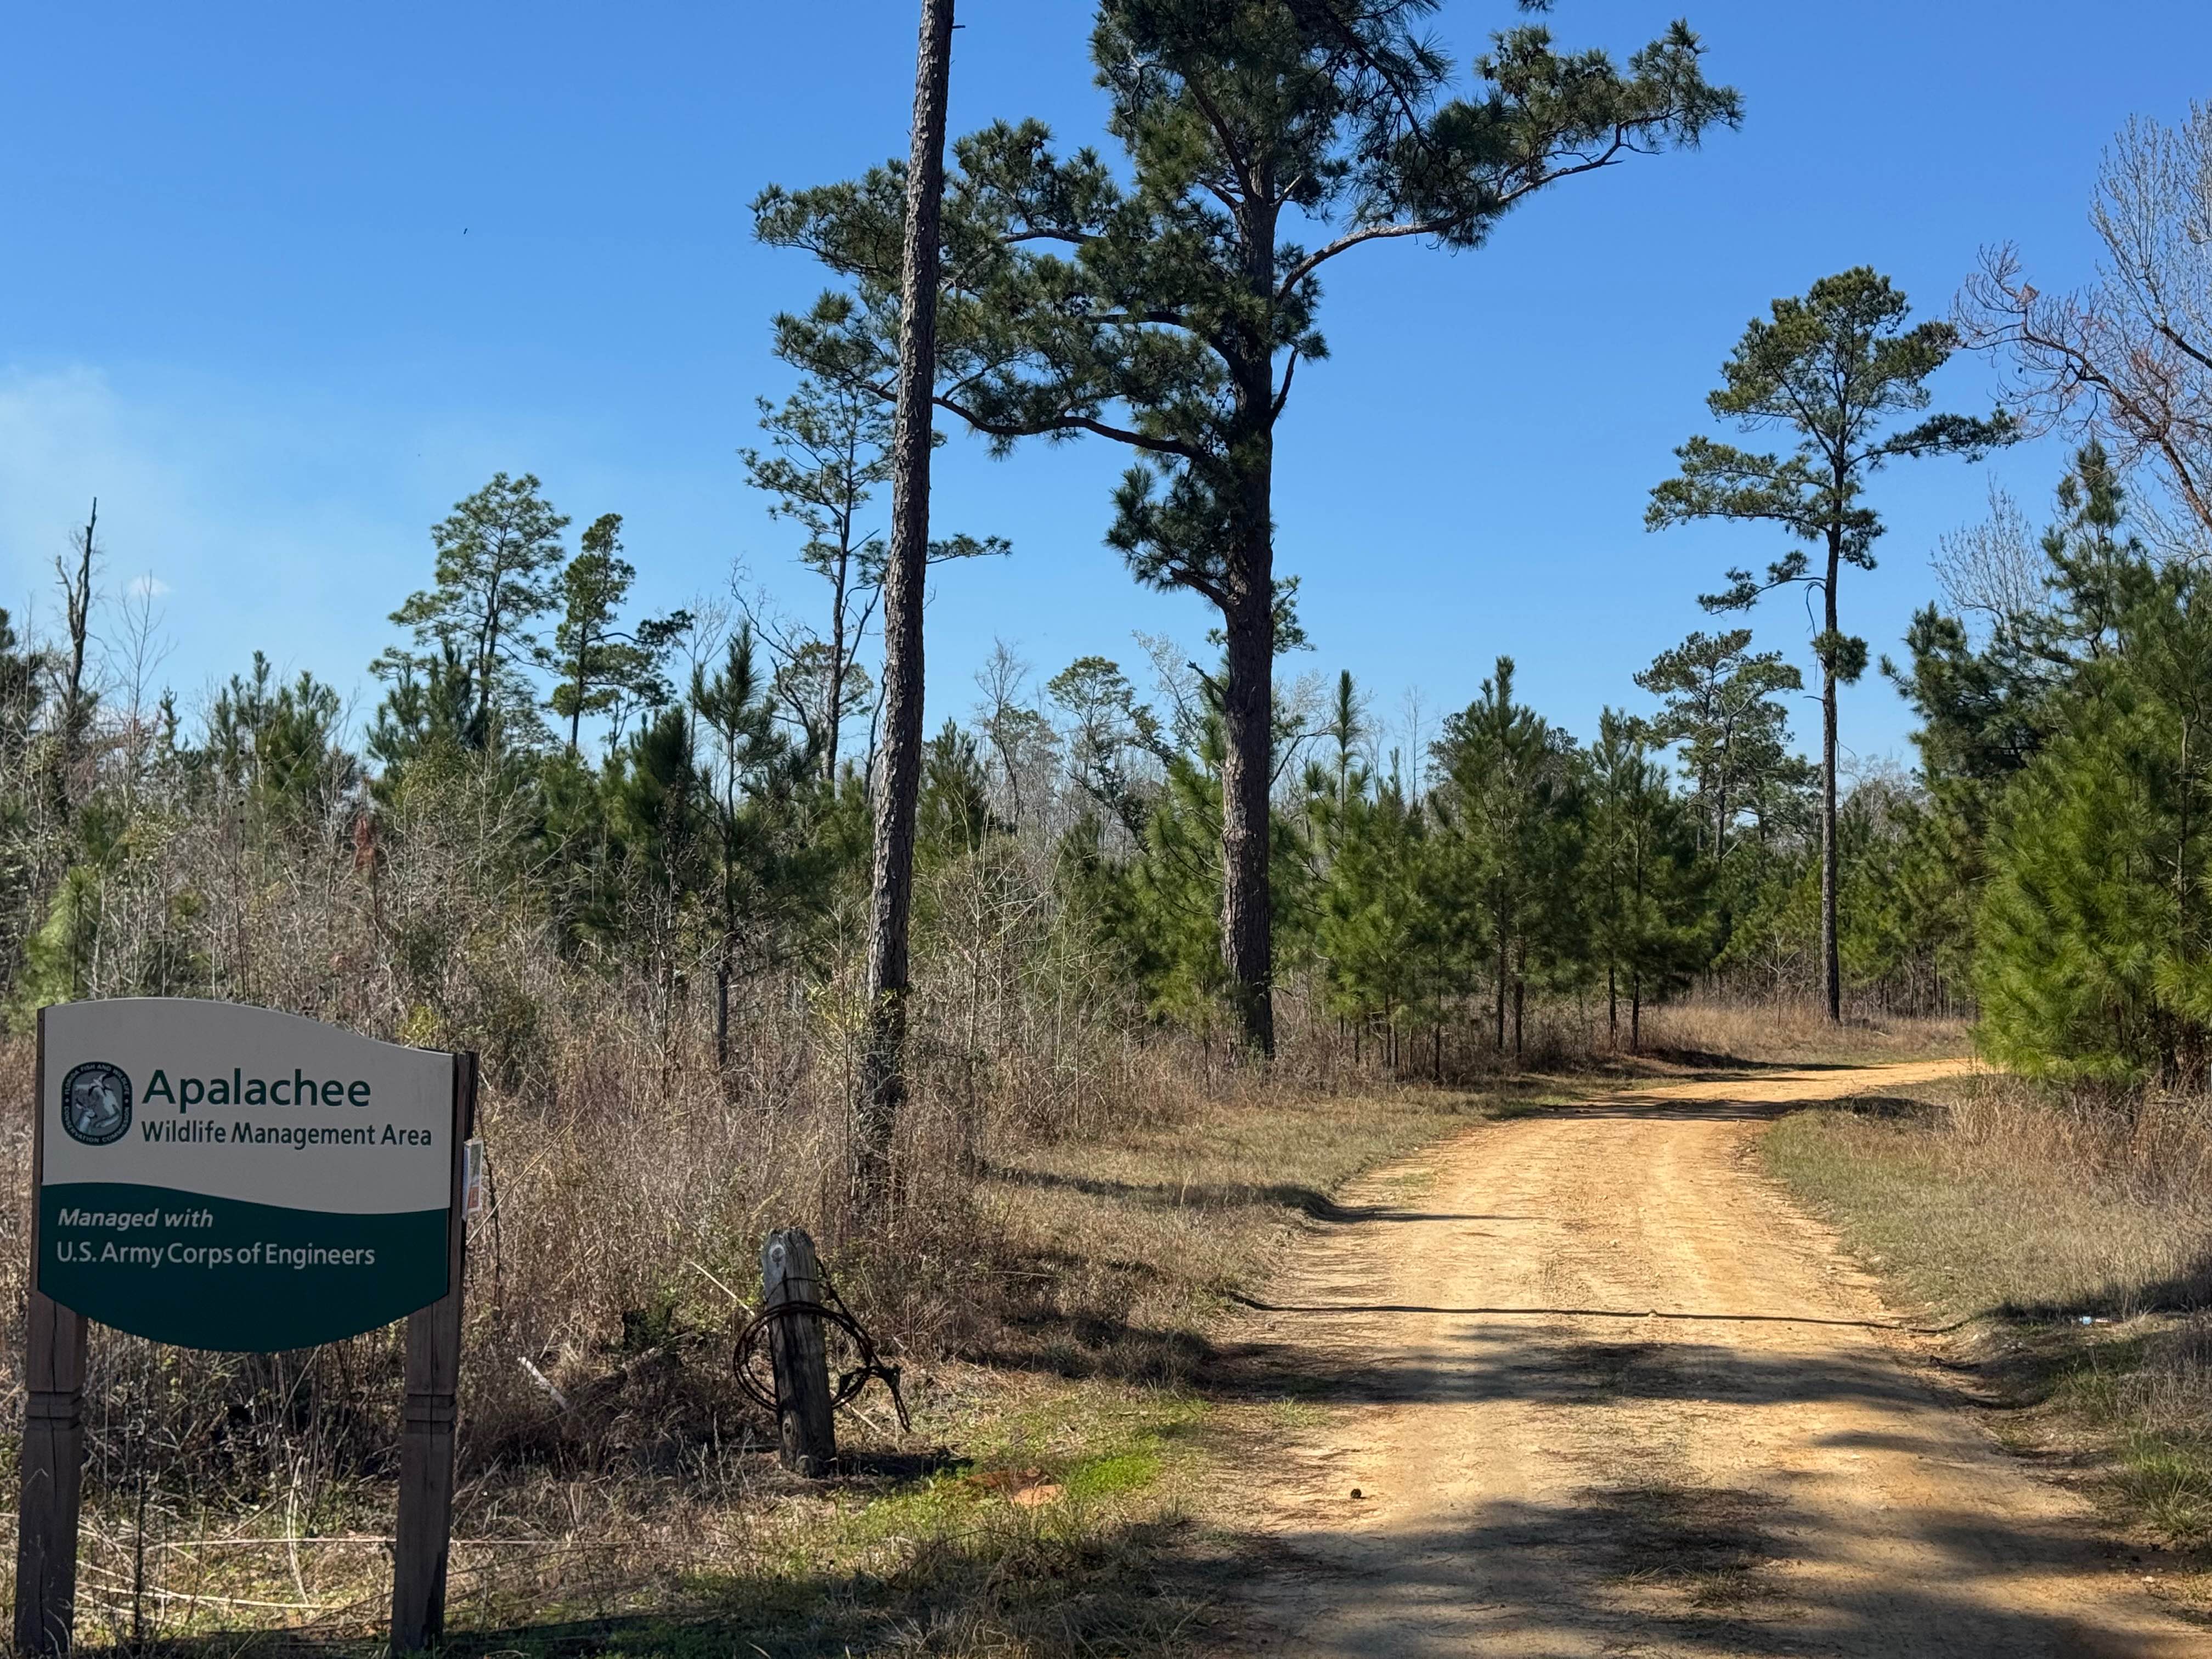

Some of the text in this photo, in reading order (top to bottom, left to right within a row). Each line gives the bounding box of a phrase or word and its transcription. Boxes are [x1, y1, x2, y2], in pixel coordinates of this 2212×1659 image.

[142, 1068, 371, 1114] Apalachee
[141, 1120, 432, 1150] Wildlife Management Area
[58, 1208, 213, 1231] Managed with
[57, 1241, 375, 1270] U.S. Army Corps of Engineers
